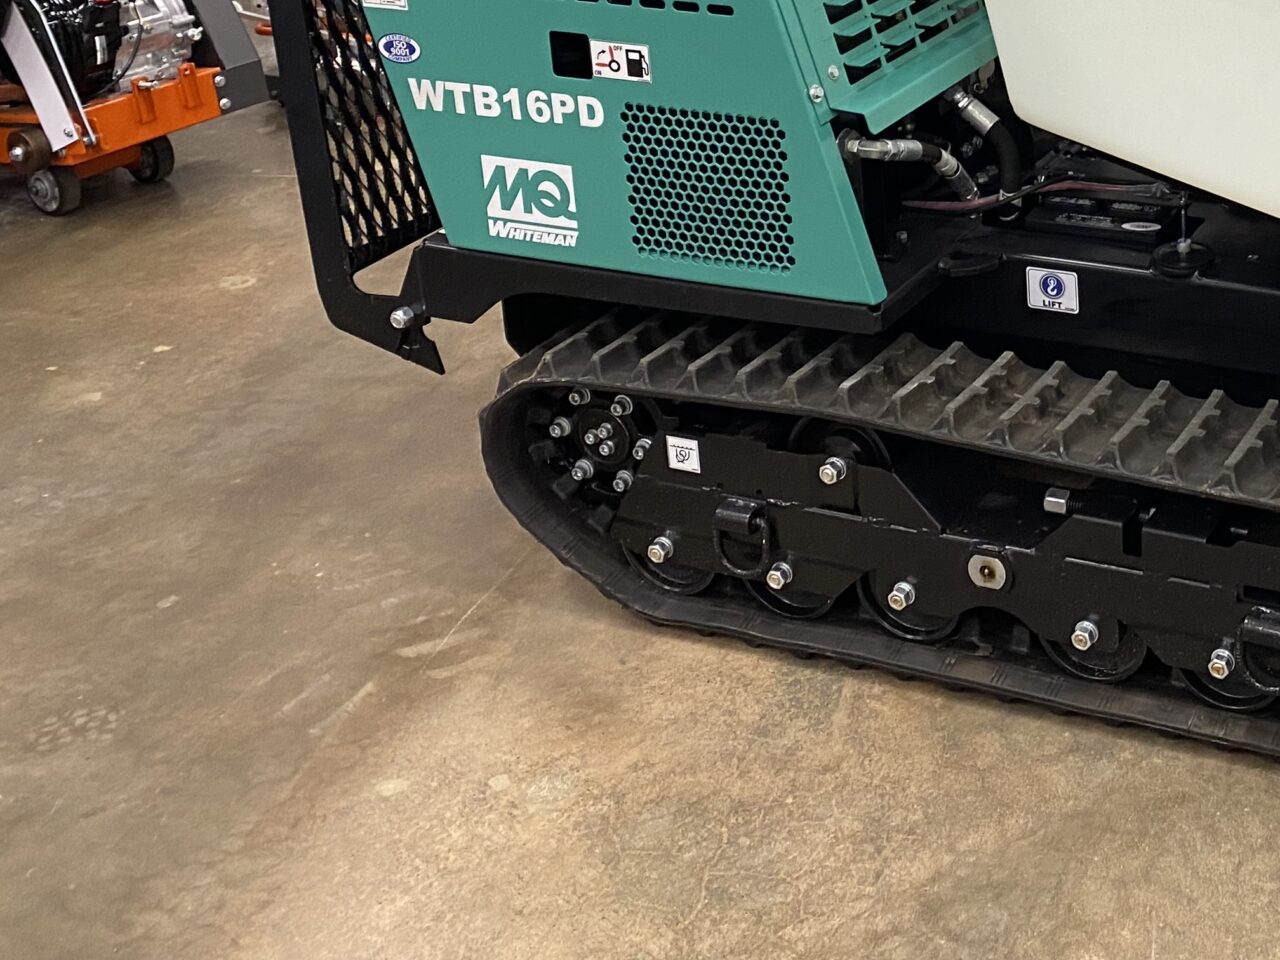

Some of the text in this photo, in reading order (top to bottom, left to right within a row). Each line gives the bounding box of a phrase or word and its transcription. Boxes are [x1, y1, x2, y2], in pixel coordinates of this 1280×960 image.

[390, 48, 410, 56] 9001
[392, 40, 408, 49] ISO
[407, 77, 605, 128] WTB16PD
[485, 164, 577, 219] MQ
[487, 219, 579, 248] WHITEMAN
[1042, 299, 1062, 309] LIFT
